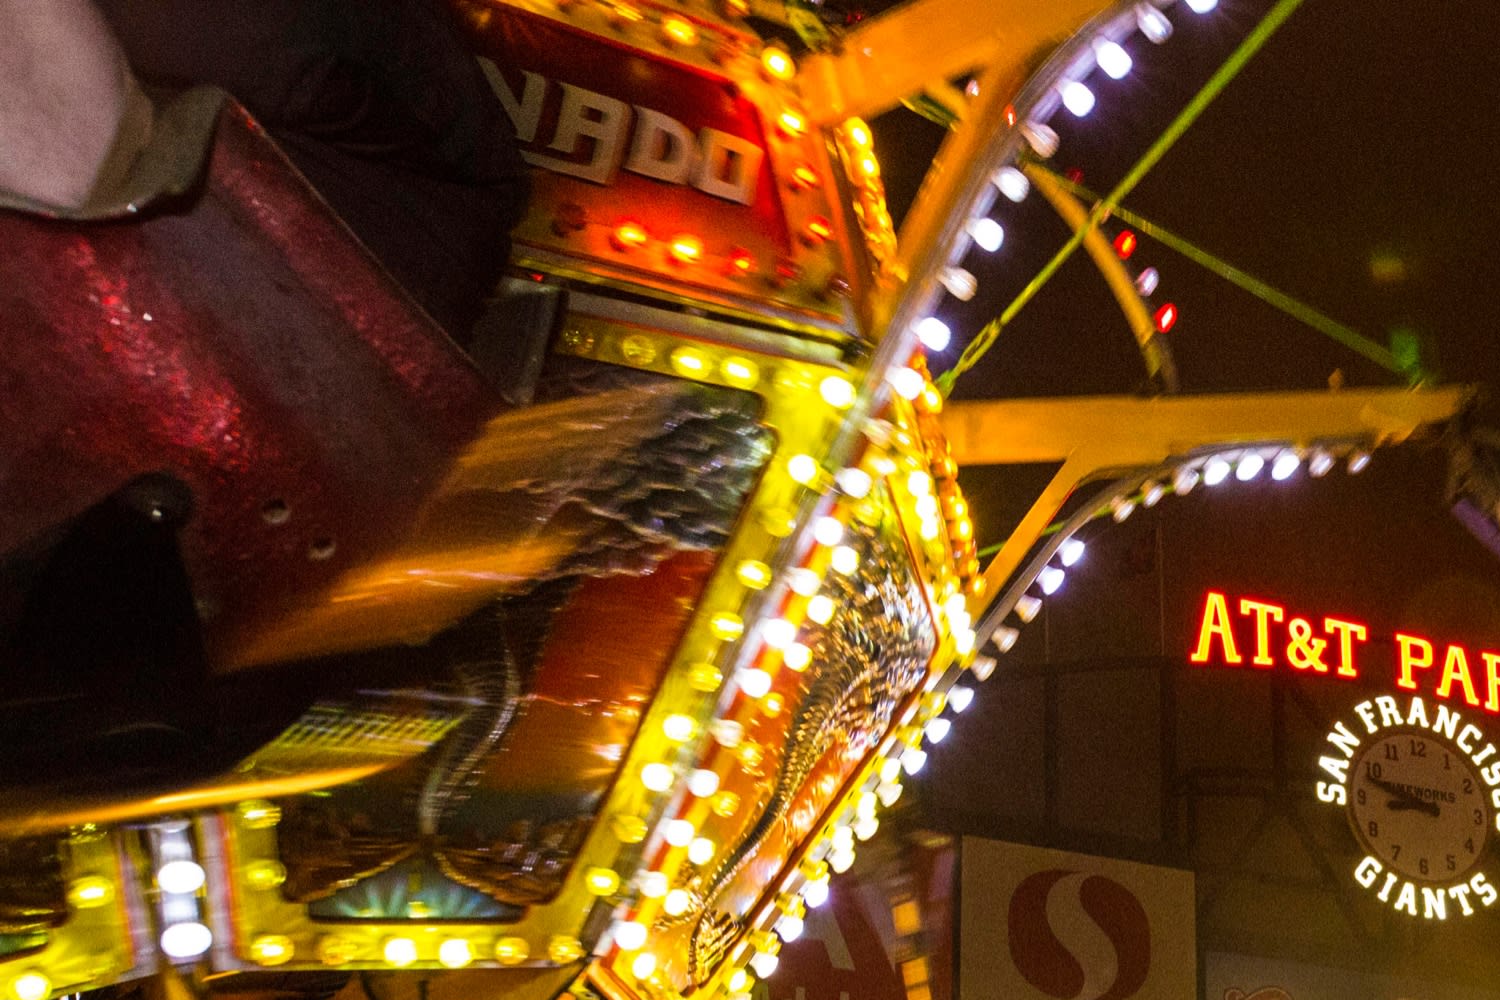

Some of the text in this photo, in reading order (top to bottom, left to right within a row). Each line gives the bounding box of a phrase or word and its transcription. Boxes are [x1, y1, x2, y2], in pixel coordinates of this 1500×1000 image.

[474, 54, 764, 207] NADO
[1191, 592, 1367, 678] AT&T
[1384, 742, 1398, 761] 11
[1409, 739, 1427, 758] 12
[1316, 720, 1361, 806] SAN
[1365, 761, 1382, 779] 10
[1442, 753, 1451, 770] 1
[1462, 777, 1473, 795] 2
[1357, 788, 1367, 806] 9
[1473, 809, 1483, 826] 3
[1368, 821, 1379, 838] 8
[1391, 844, 1401, 861] 7
[1464, 837, 1475, 854] 4
[1418, 858, 1429, 876] 6
[1446, 854, 1456, 871] 5
[1354, 855, 1498, 920] GIANTS
